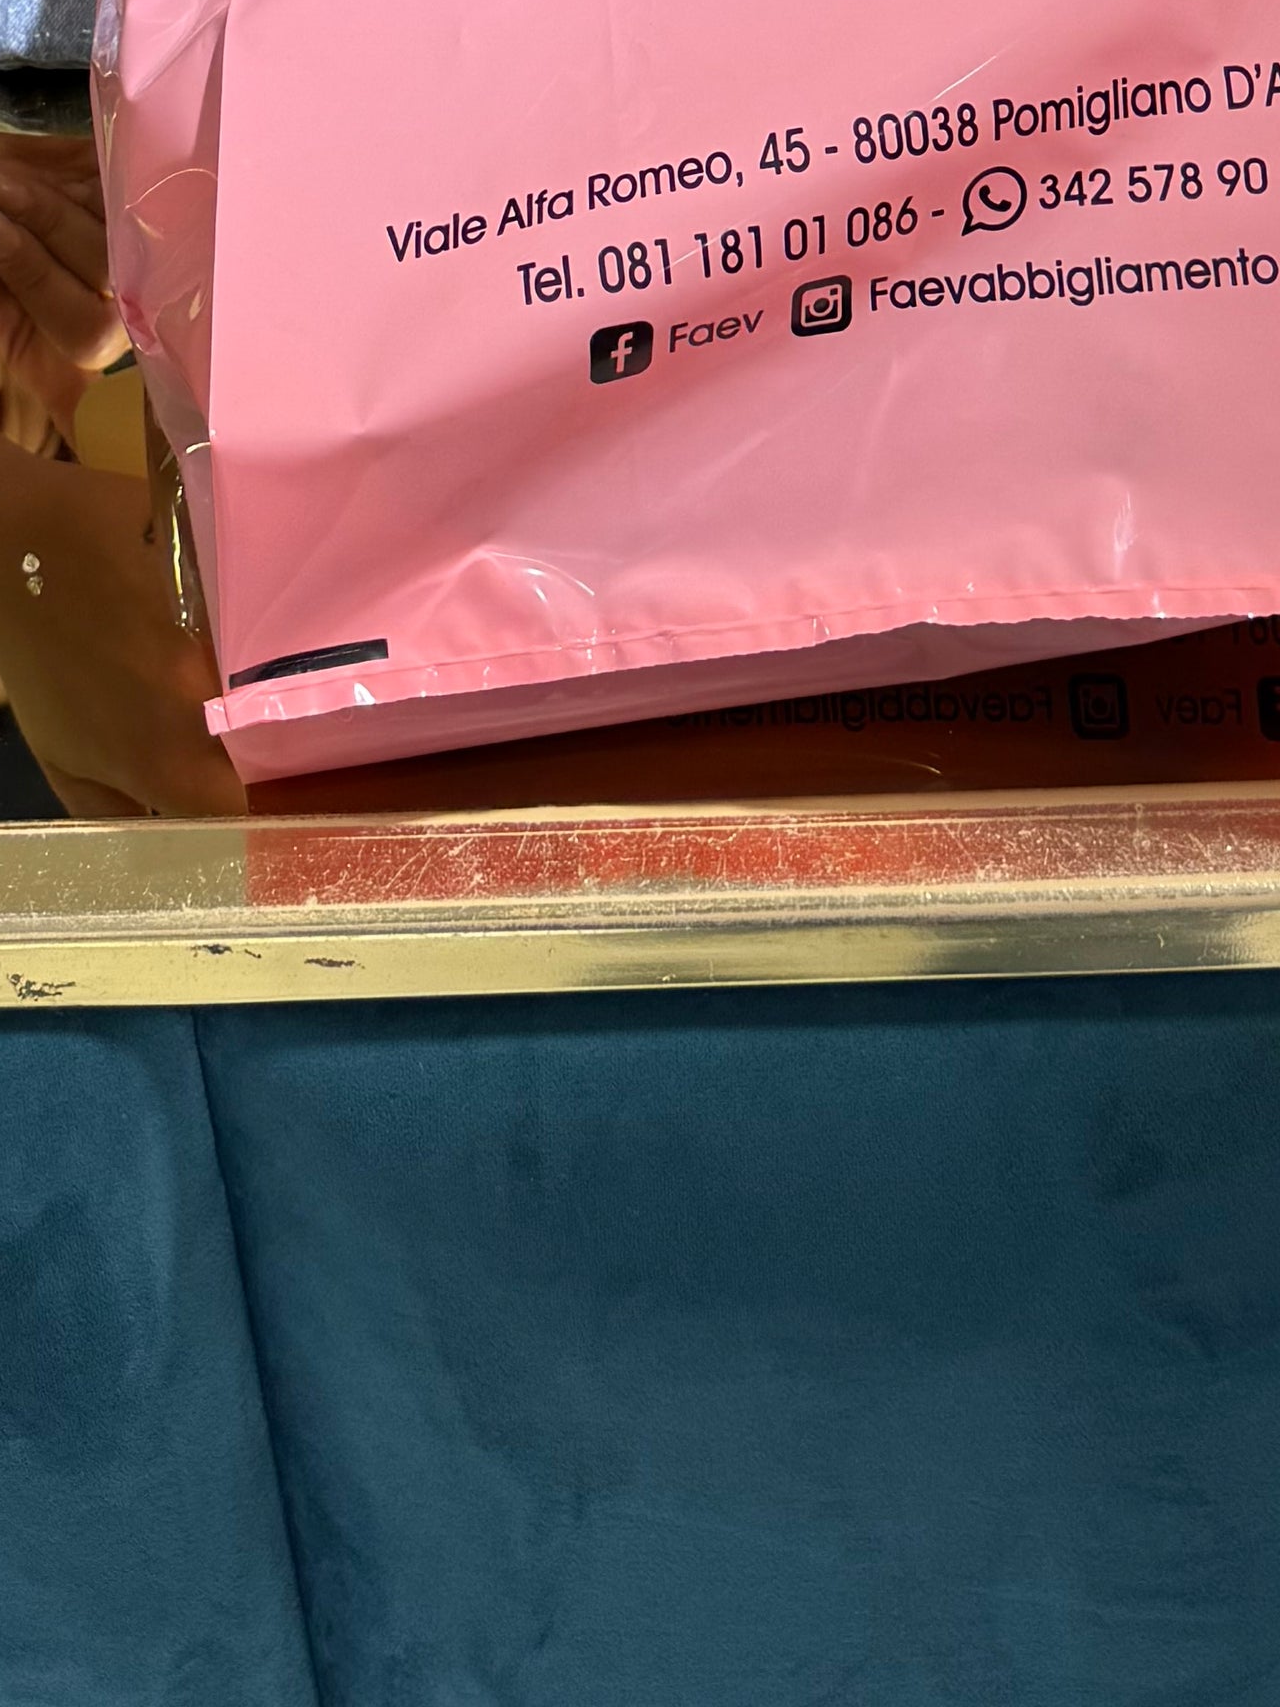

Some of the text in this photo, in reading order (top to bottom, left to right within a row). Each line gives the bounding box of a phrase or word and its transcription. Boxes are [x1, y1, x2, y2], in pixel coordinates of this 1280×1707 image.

[387, 213, 487, 262] Viale
[497, 189, 573, 236] Alfa
[589, 152, 743, 210] Romeo,
[760, 128, 810, 175] 45
[853, 103, 978, 163] 80038
[993, 77, 1211, 141] Pomigliano
[517, 255, 584, 305] Tel.
[598, 239, 671, 293] 081
[694, 226, 762, 278] 181
[784, 215, 825, 260] 01
[847, 196, 918, 247] 086
[1039, 169, 1113, 209] 342
[1128, 162, 1203, 203] 578
[1217, 158, 1268, 196] 90
[670, 310, 763, 353] Faev
[871, 248, 1278, 311] Faevabbigliamento
